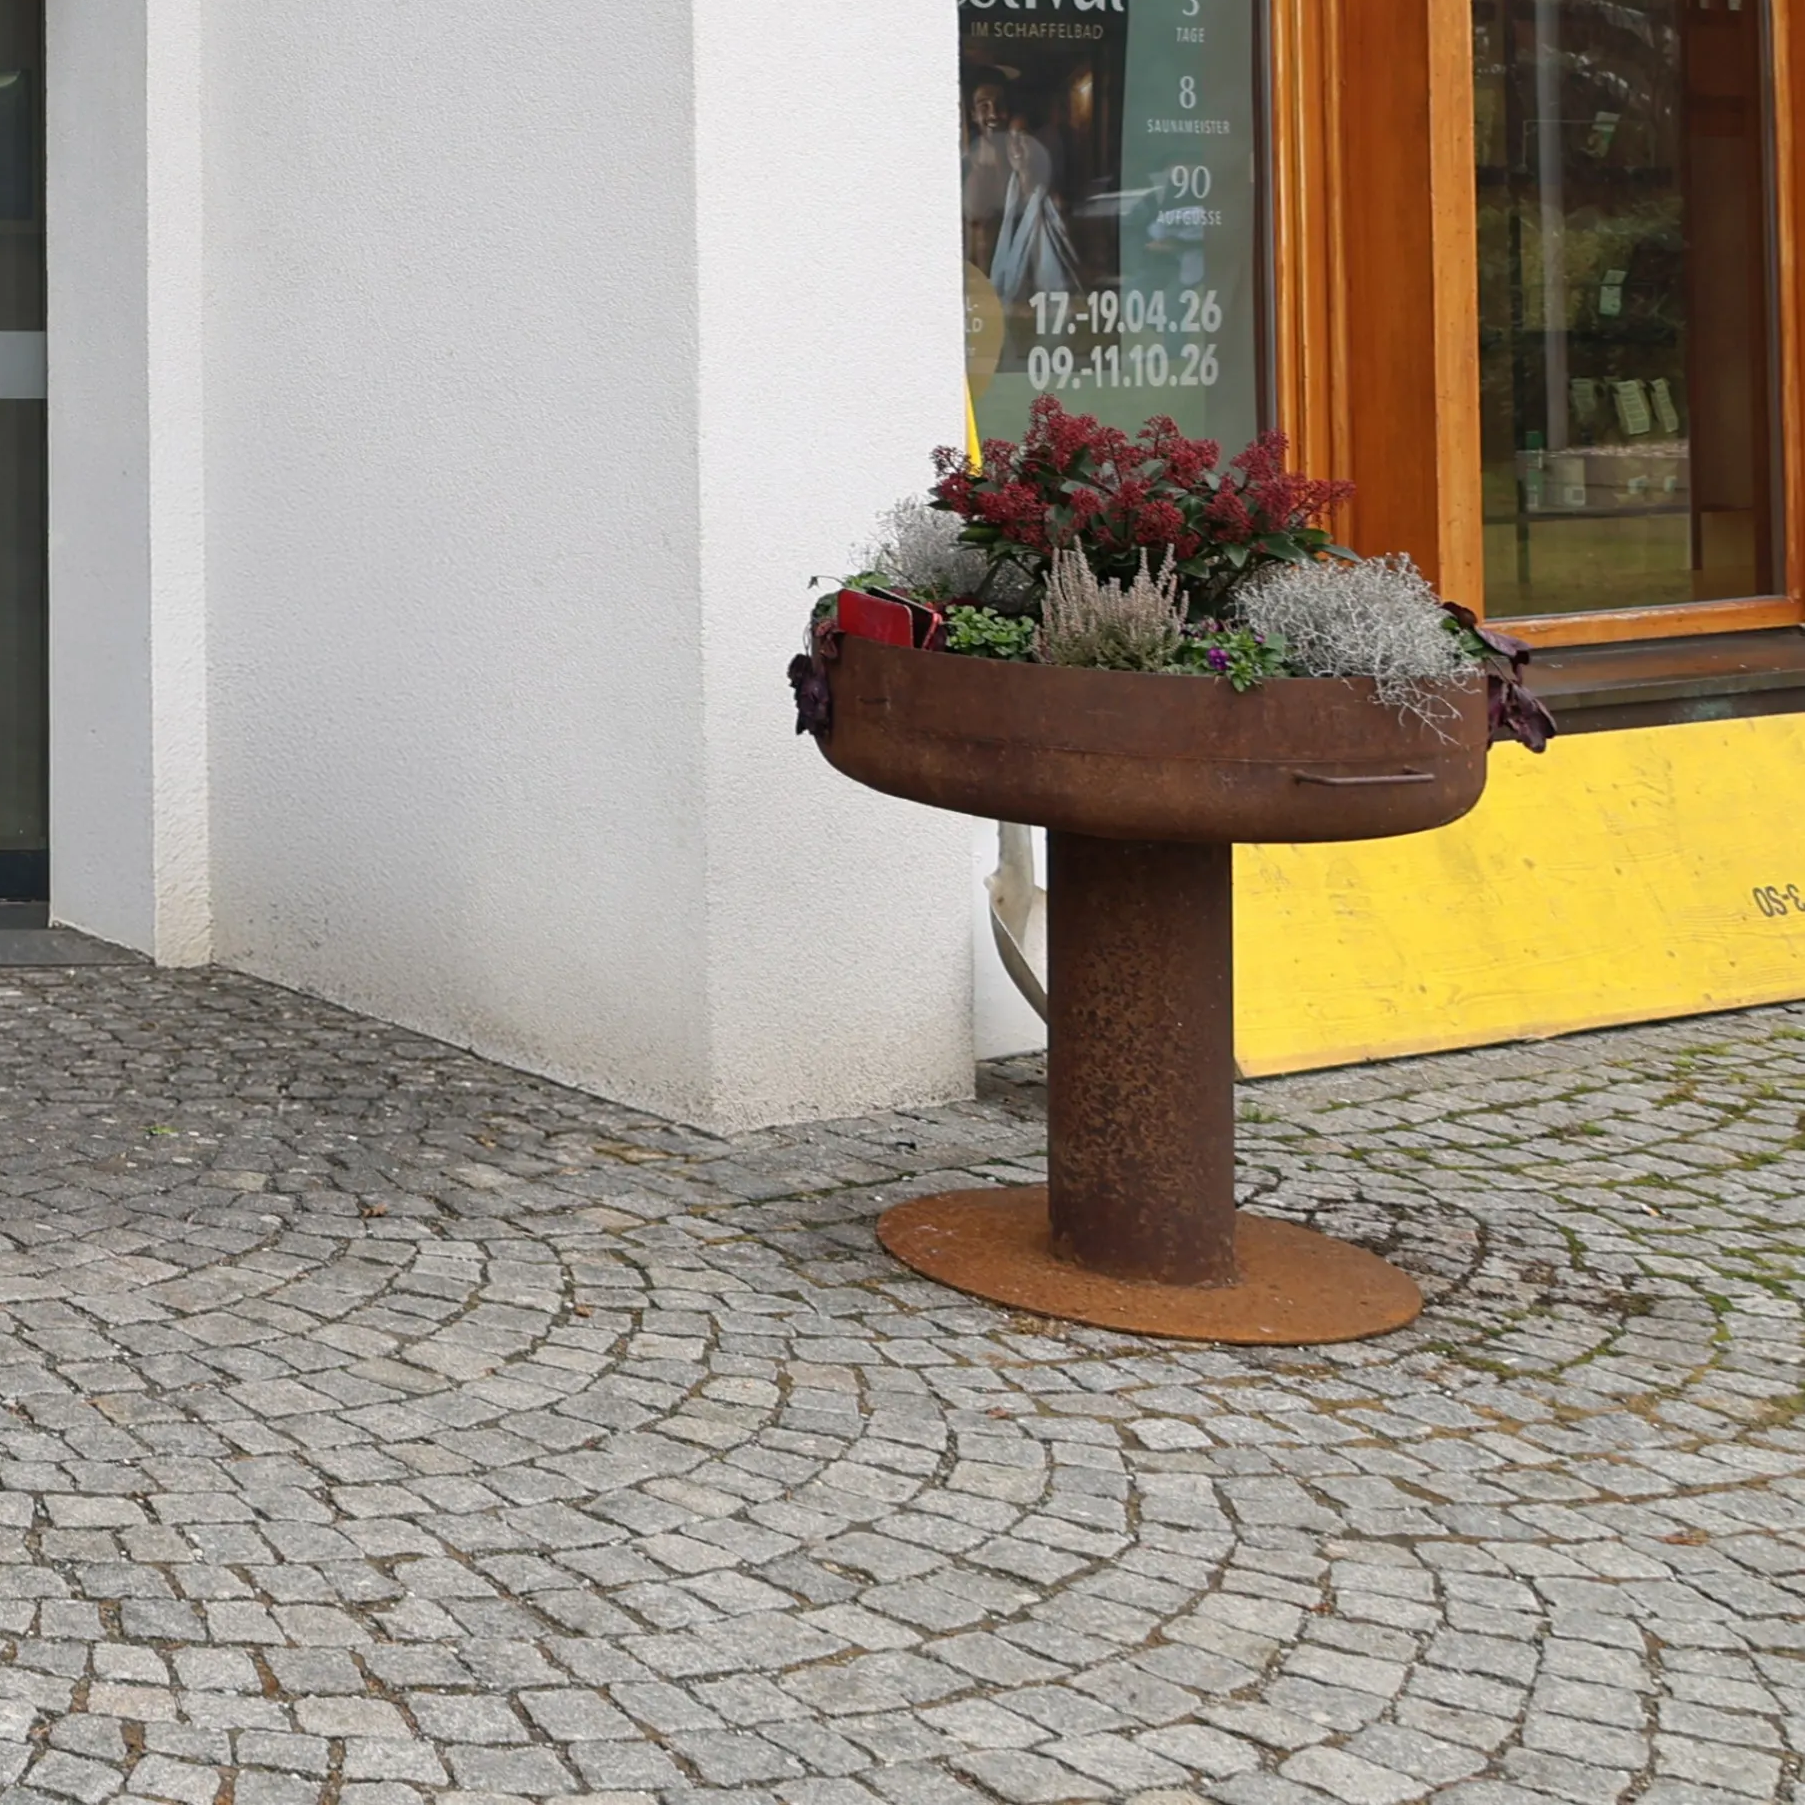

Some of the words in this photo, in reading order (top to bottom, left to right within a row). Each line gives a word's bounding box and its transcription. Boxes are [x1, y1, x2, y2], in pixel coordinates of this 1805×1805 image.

[970, 21, 989, 37] IM
[993, 21, 1104, 39] SCHAFFELBAD
[1175, 26, 1206, 43] TAGE
[1178, 75, 1197, 109] 8
[1146, 118, 1231, 134] SAUNAMEISTER
[1170, 164, 1212, 200] 90
[1028, 289, 1223, 335] 17.-19.04.26
[1027, 344, 1220, 391] 09.-11.10.26
